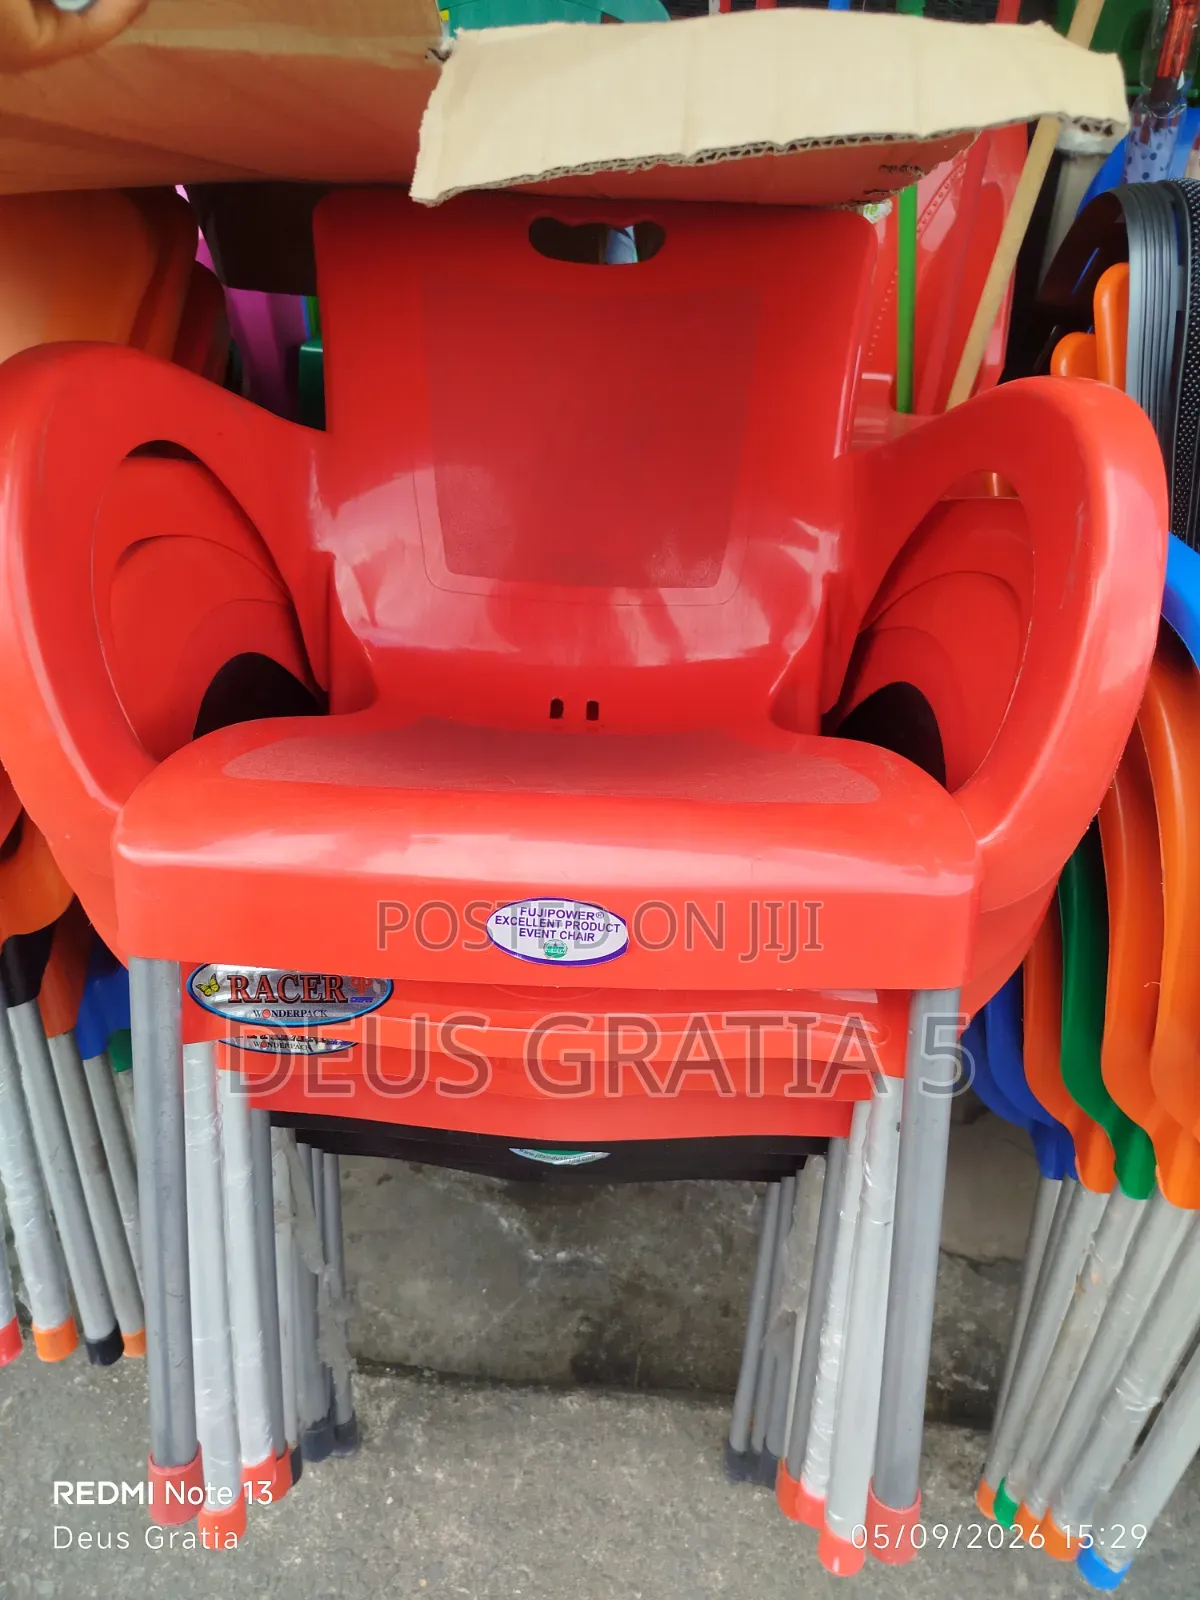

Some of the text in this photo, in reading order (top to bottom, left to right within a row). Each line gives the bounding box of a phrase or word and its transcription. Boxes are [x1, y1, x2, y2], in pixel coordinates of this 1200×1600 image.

[495, 915, 621, 934] EXCELLENT PRODUCT
[519, 927, 595, 942] EVENT CHAIR
[227, 974, 348, 1004] RACER
[252, 1008, 328, 1019] WONDERPACK
